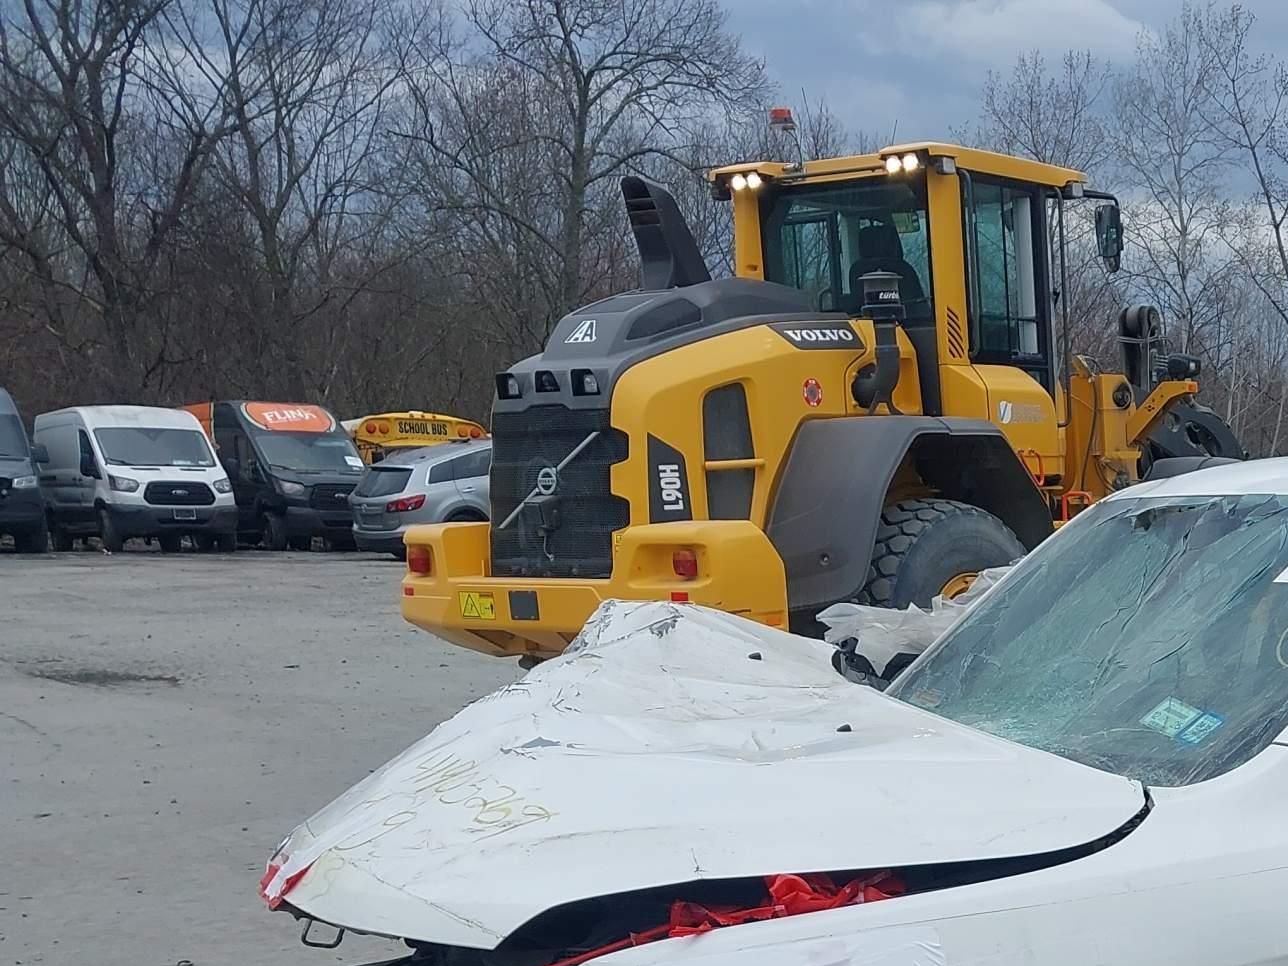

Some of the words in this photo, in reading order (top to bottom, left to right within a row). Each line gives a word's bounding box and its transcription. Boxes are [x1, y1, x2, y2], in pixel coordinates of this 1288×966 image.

[783, 329, 854, 341] VOLVO
[398, 421, 430, 435] SCHOOL
[431, 423, 448, 436] BUS
[658, 464, 684, 510] L90H
